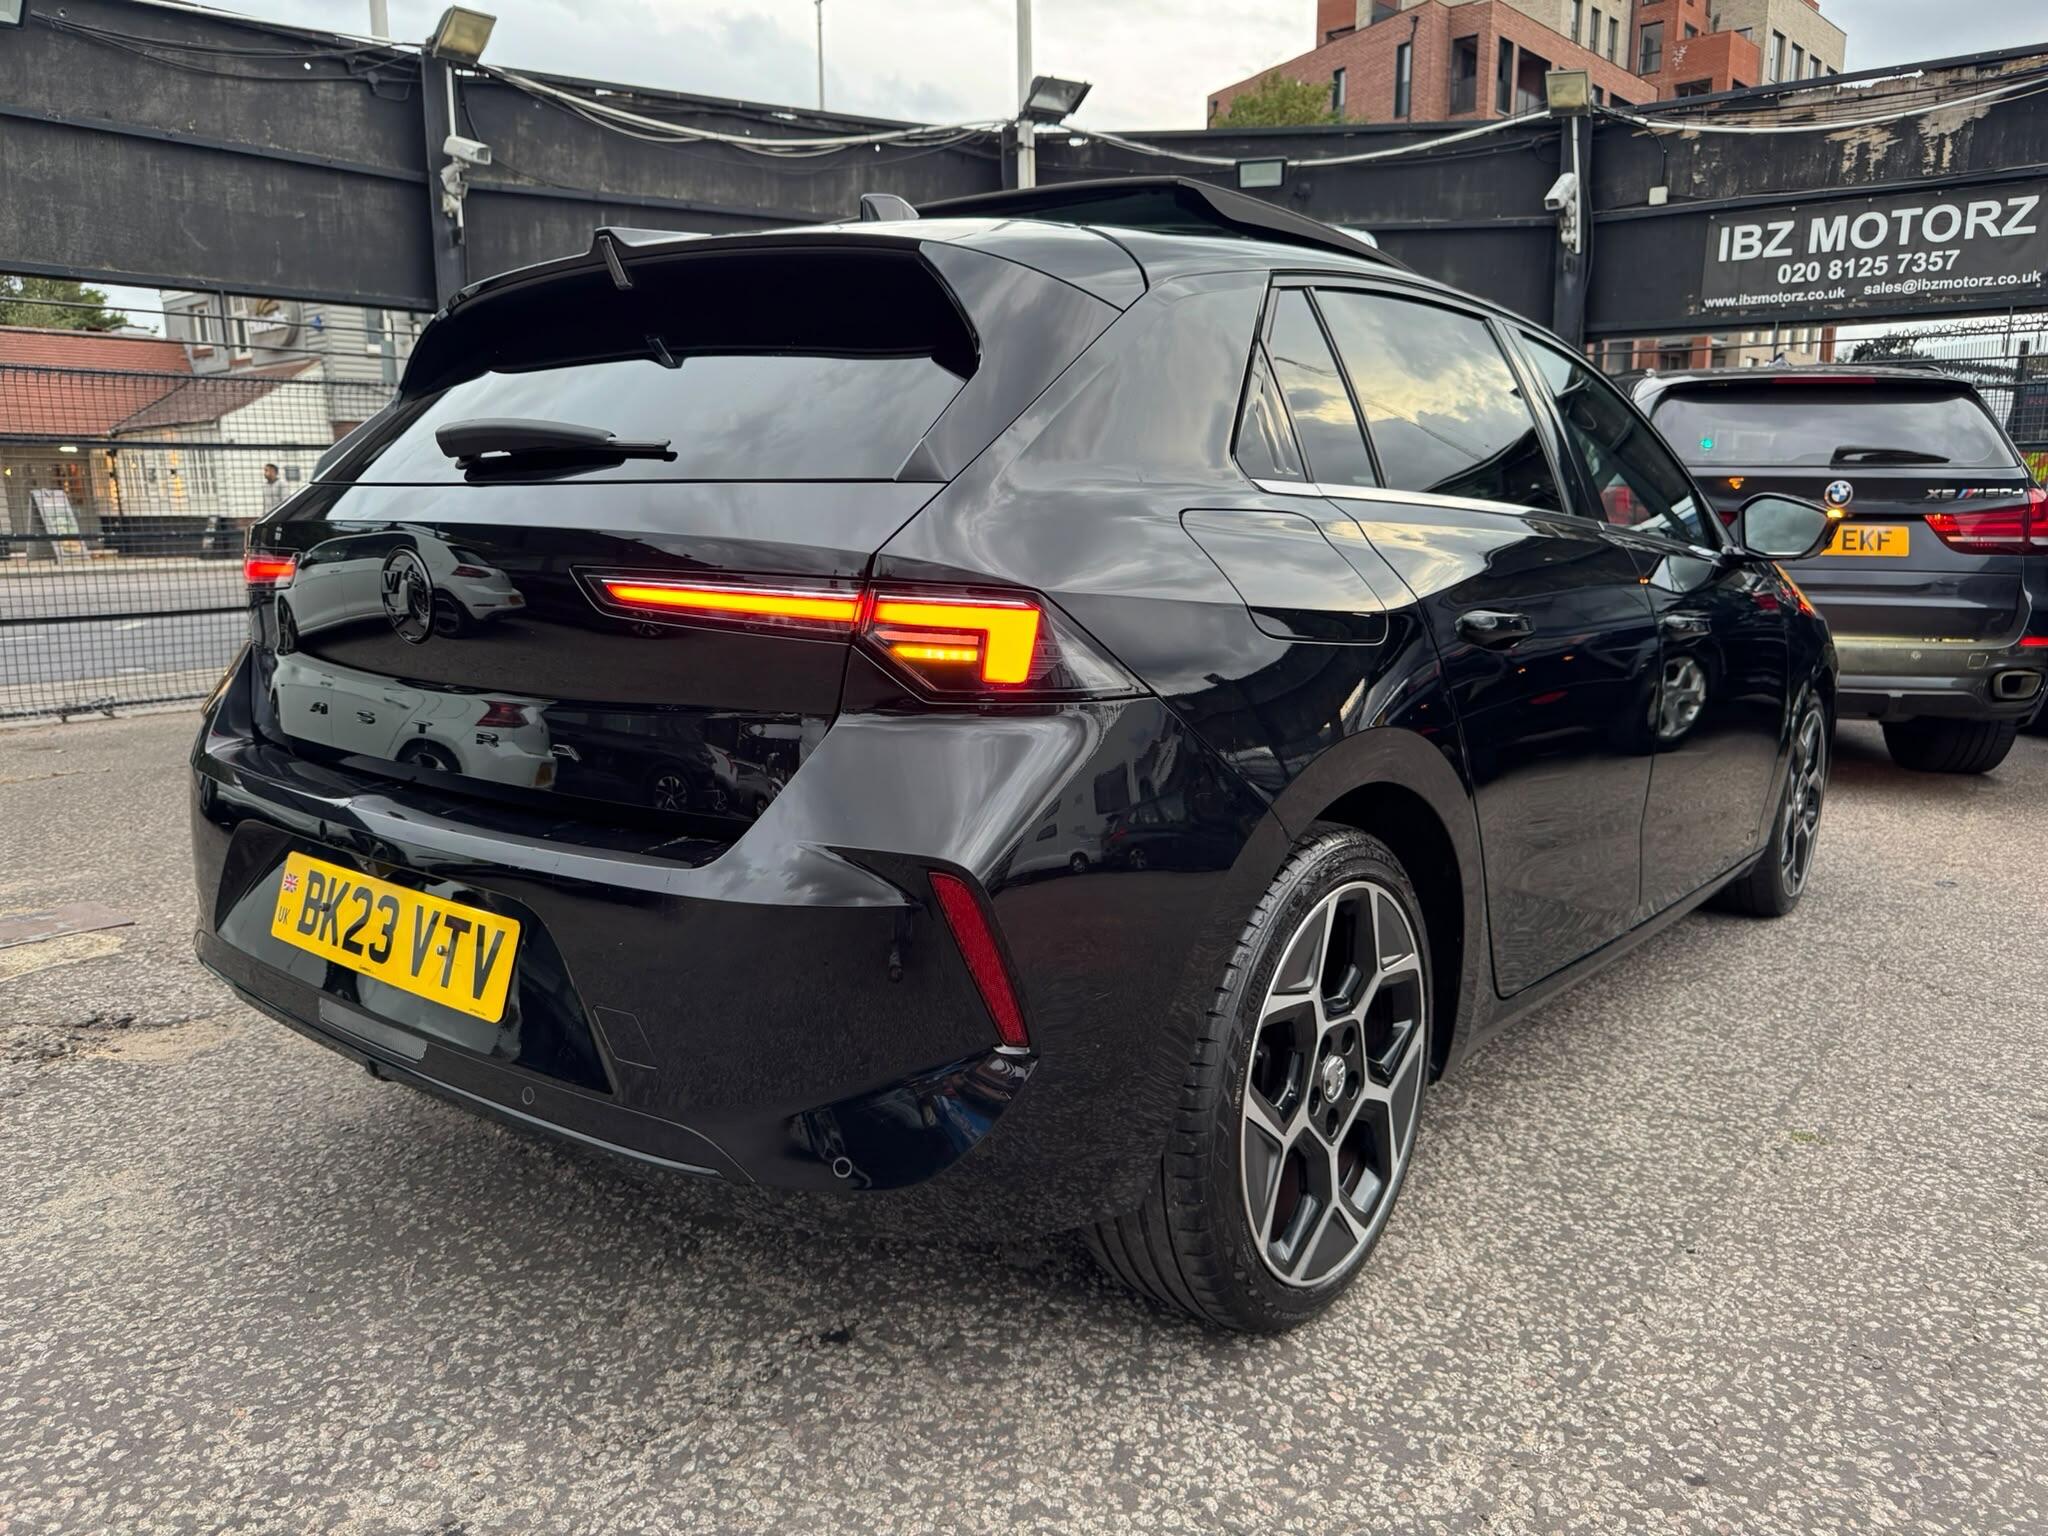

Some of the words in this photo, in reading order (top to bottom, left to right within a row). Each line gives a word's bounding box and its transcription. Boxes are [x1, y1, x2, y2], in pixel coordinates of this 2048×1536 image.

[1718, 220, 1795, 262] IBZ
[1807, 195, 2040, 254] MOTORZ
[1777, 261, 1821, 284] 020
[1827, 255, 1888, 280] 8125
[1897, 249, 1960, 274] 7357
[1704, 286, 1846, 309] www.ibzmotorz.co.uk
[1863, 271, 2042, 296] sales@ibzmotorz.co.uk
[1842, 529, 1892, 551] EKF
[277, 905, 291, 924] UK
[297, 869, 400, 965] BK23
[411, 904, 506, 1000] VTV
